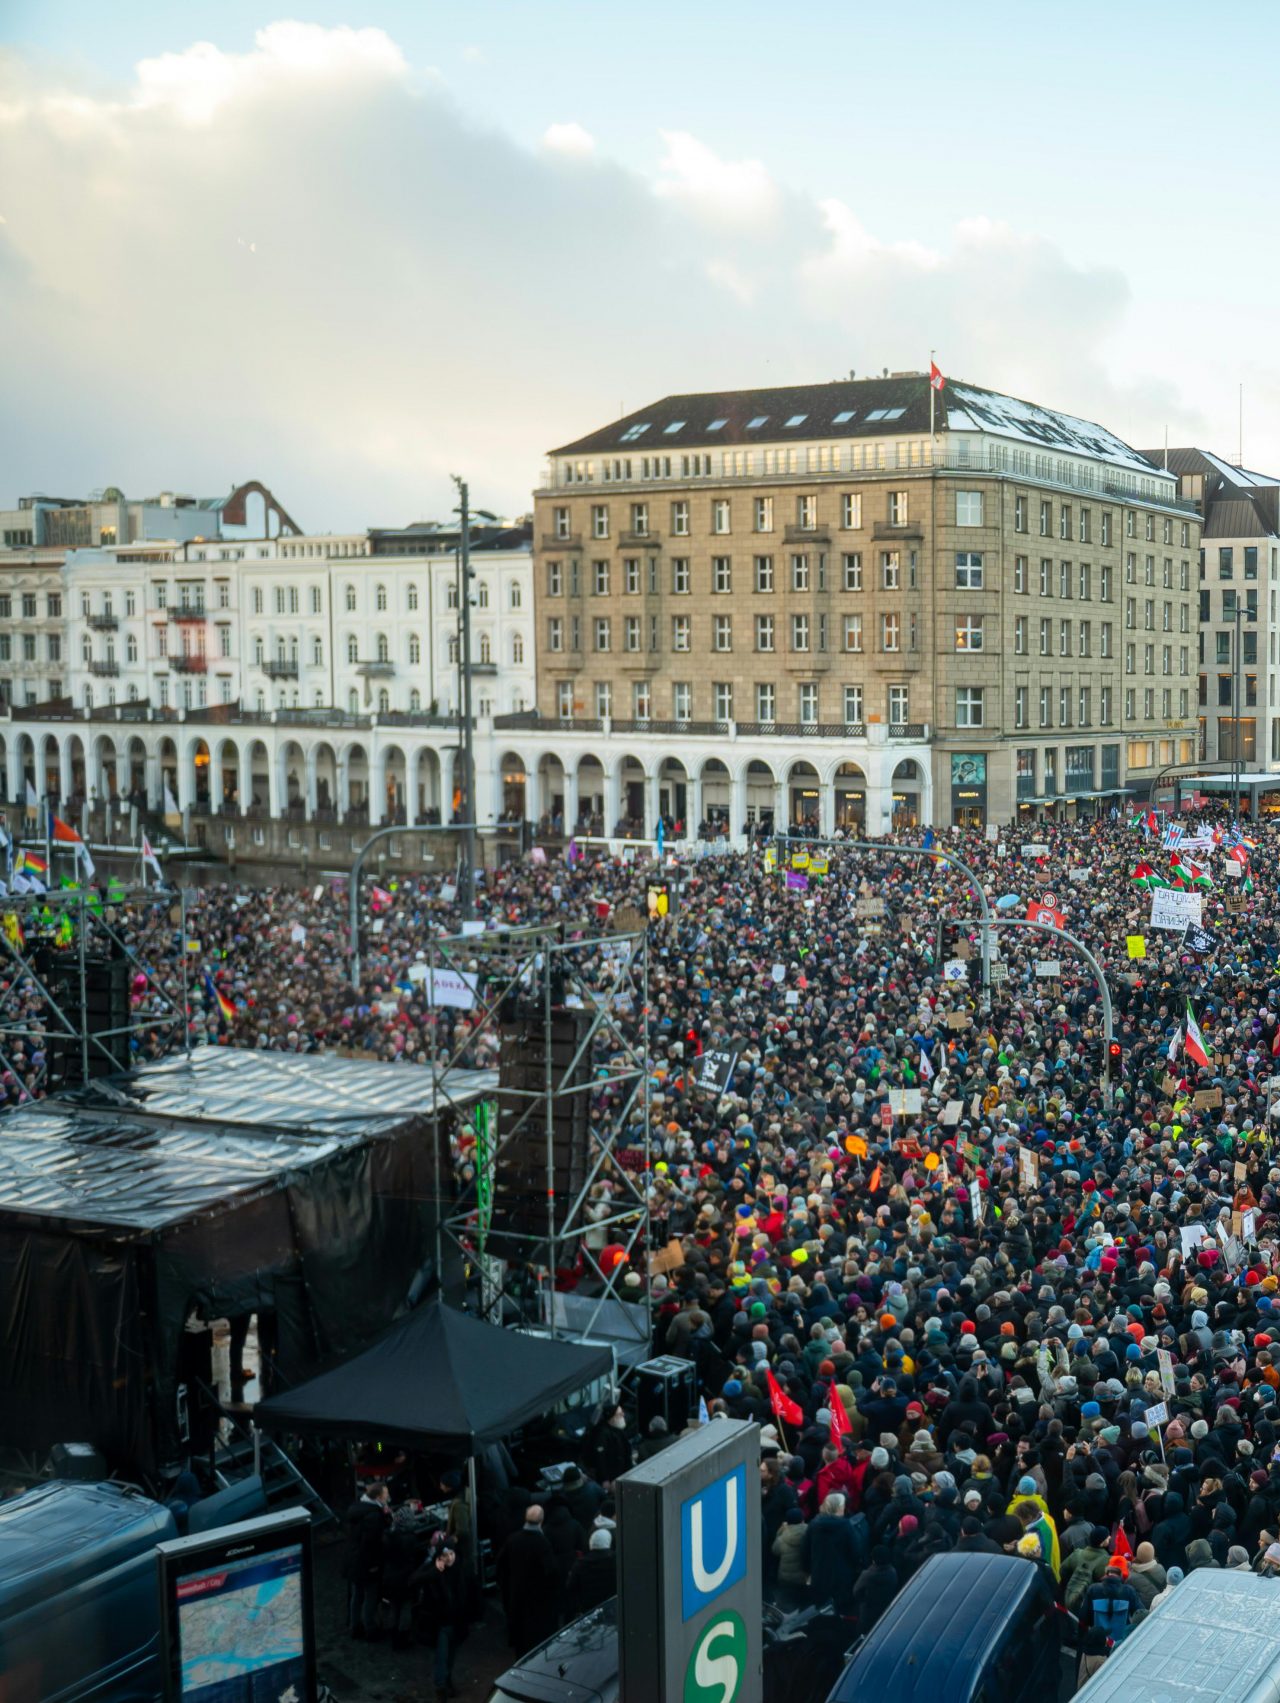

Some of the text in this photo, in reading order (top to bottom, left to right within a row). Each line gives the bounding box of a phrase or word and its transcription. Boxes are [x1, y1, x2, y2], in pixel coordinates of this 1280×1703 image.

[1045, 896, 1054, 905] 30
[691, 1475, 738, 1593] U
[694, 1620, 739, 1703] S
